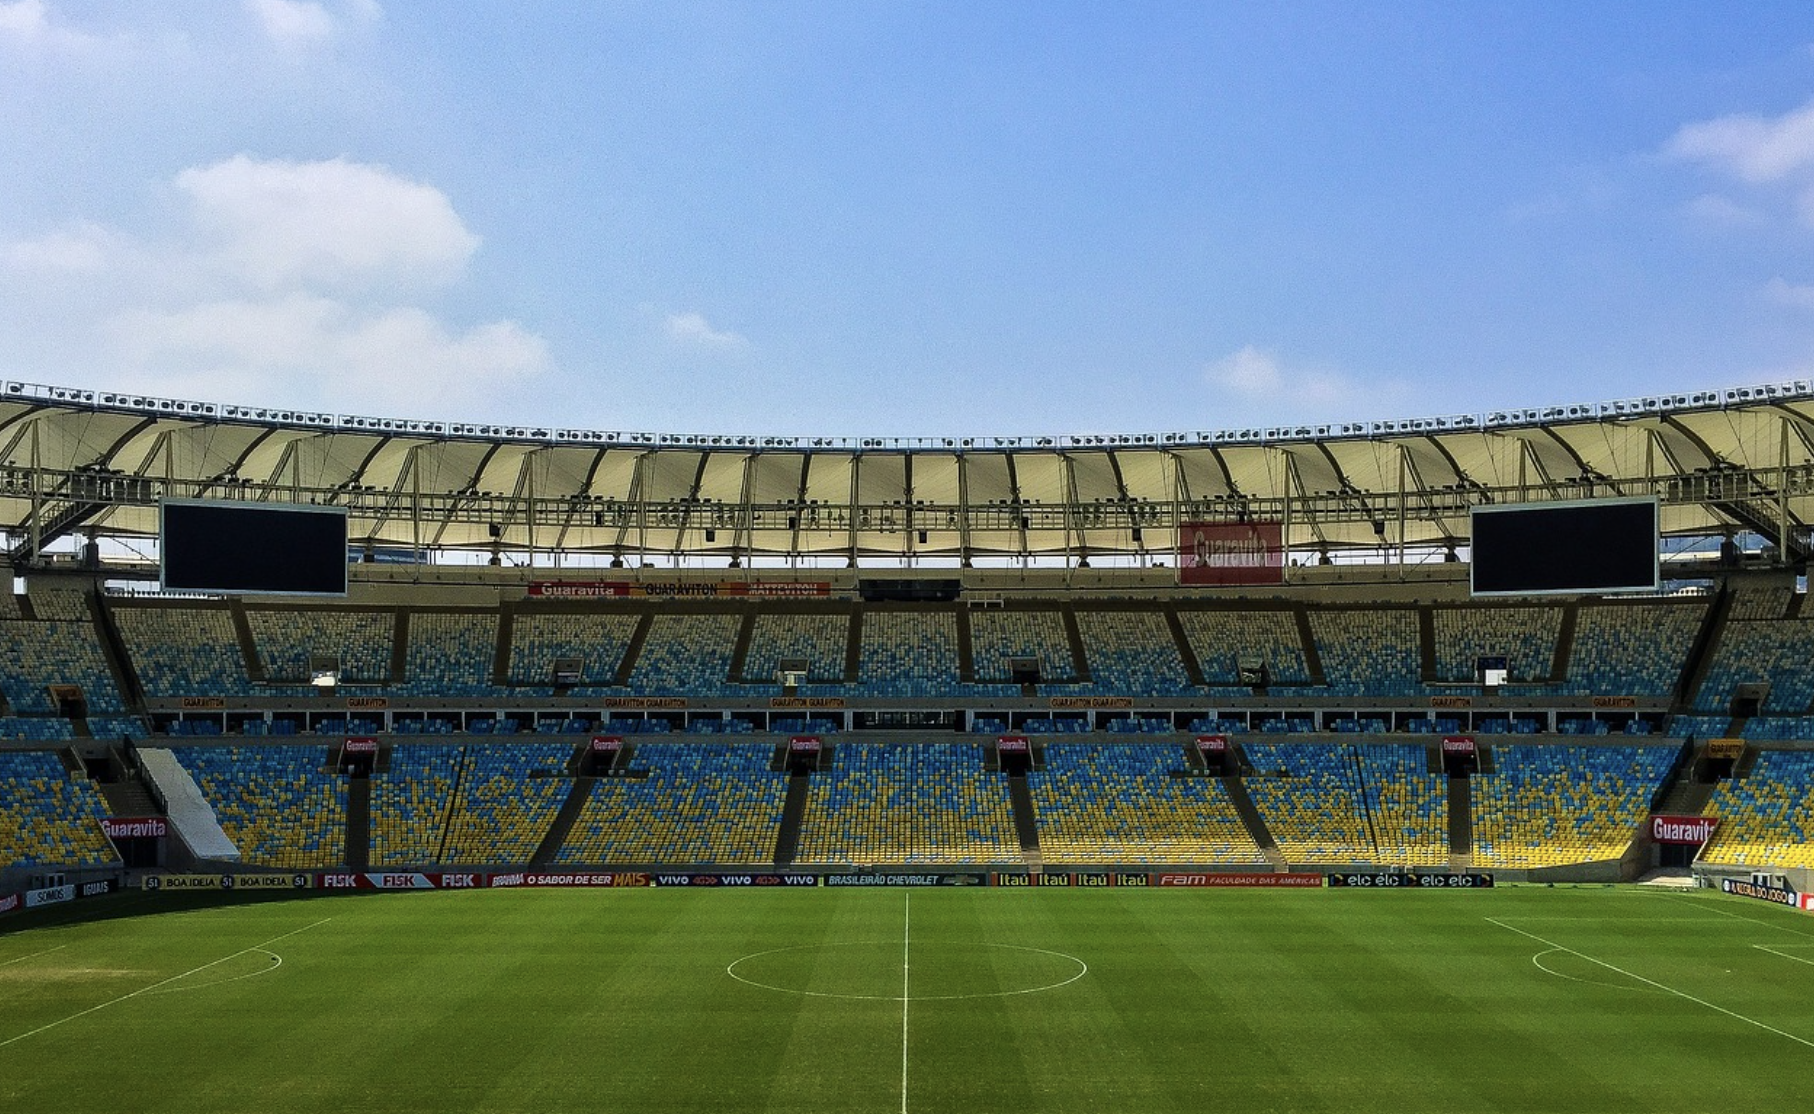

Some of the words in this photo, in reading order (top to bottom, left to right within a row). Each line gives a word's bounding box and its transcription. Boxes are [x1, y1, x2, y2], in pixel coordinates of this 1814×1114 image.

[541, 583, 614, 595] Guaravita
[646, 583, 717, 595] GUARAVITON
[102, 818, 165, 837] Guaravita
[166, 878, 187, 887] BOA
[189, 878, 216, 887] IDEIA
[240, 878, 260, 887] BOA
[262, 877, 287, 886] IDEIA
[324, 875, 357, 887] FISK
[383, 875, 415, 887] FISK
[442, 875, 474, 887] FISK
[527, 876, 536, 885] O
[537, 876, 573, 885] SABOR
[575, 876, 588, 885] DE
[590, 876, 611, 885] SER
[613, 873, 646, 887] MAIS
[828, 873, 885, 885] BRASILEIRÃO
[887, 876, 939, 885] CHEVROLET
[1000, 874, 1029, 886] Itaú
[1040, 874, 1068, 886] Itaú
[1078, 874, 1107, 886] Itaú
[1117, 874, 1146, 886] Itaú
[1209, 877, 1254, 885] FACULDADE
[1259, 877, 1275, 885] DAS
[1278, 876, 1320, 885] AMÉRICAS
[83, 881, 110, 896] IGUAIS
[1757, 886, 1767, 898] DO
[1768, 888, 1788, 903] JOGO
[37, 888, 65, 903] SOMOS
